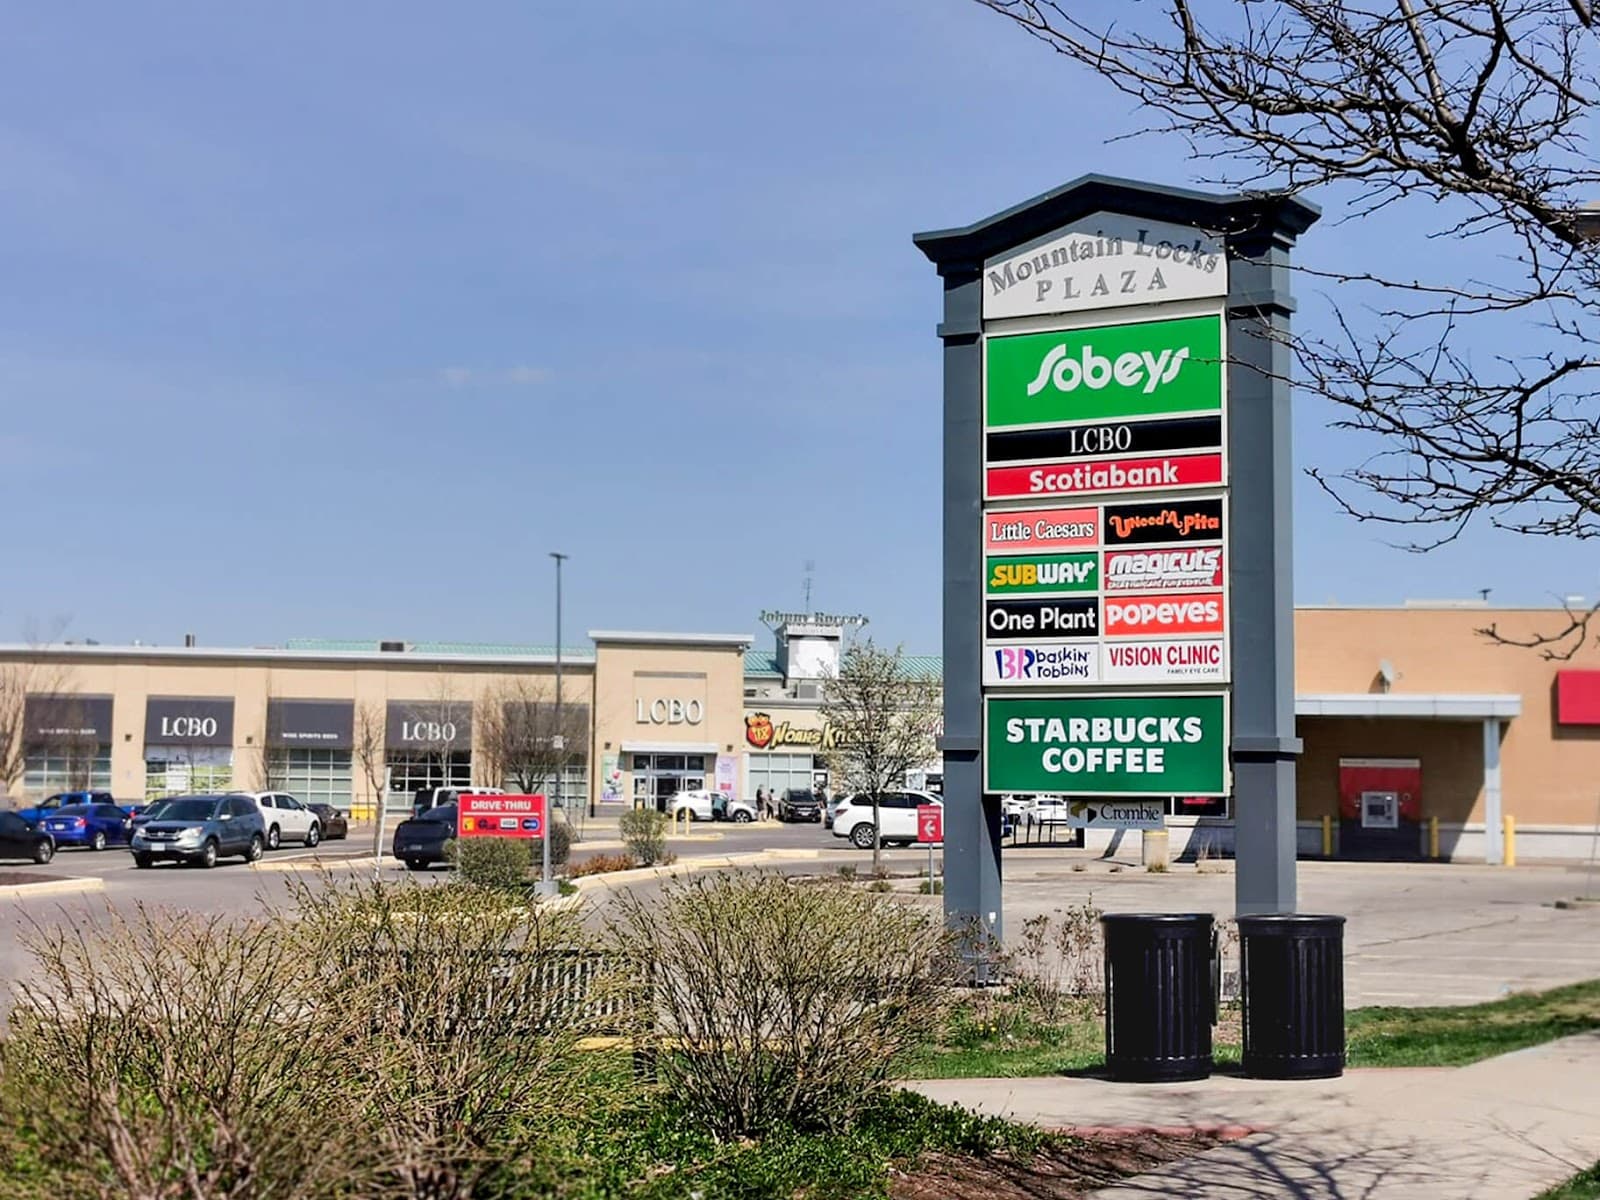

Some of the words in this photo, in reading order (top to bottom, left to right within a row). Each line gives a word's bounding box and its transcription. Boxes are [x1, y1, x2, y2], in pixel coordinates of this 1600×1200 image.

[987, 230, 1123, 296] Mountain
[1132, 229, 1220, 273] Locks
[1036, 267, 1168, 302] PLAZA
[1027, 344, 1190, 397] Sobeys
[1070, 426, 1132, 453] LCBO
[1029, 460, 1179, 492] Scotiabank
[991, 521, 1031, 542] Little
[1034, 520, 1095, 540] Caesars
[990, 559, 1096, 588] SUBWAY
[990, 608, 1035, 631] One
[1040, 606, 1096, 631] Plant
[1035, 647, 1088, 664] baskin
[1109, 646, 1162, 667] VISION
[1166, 645, 1220, 666] CLINIC
[1037, 663, 1089, 678] robbins
[636, 697, 705, 725] LCBO
[161, 716, 217, 737] LCBO
[401, 720, 456, 741] LCBO
[1006, 717, 1203, 743] STARBUCKS
[1041, 747, 1165, 773] COFFEE
[470, 800, 532, 810] DRIVE-THRU
[1100, 803, 1159, 821] Crombie
